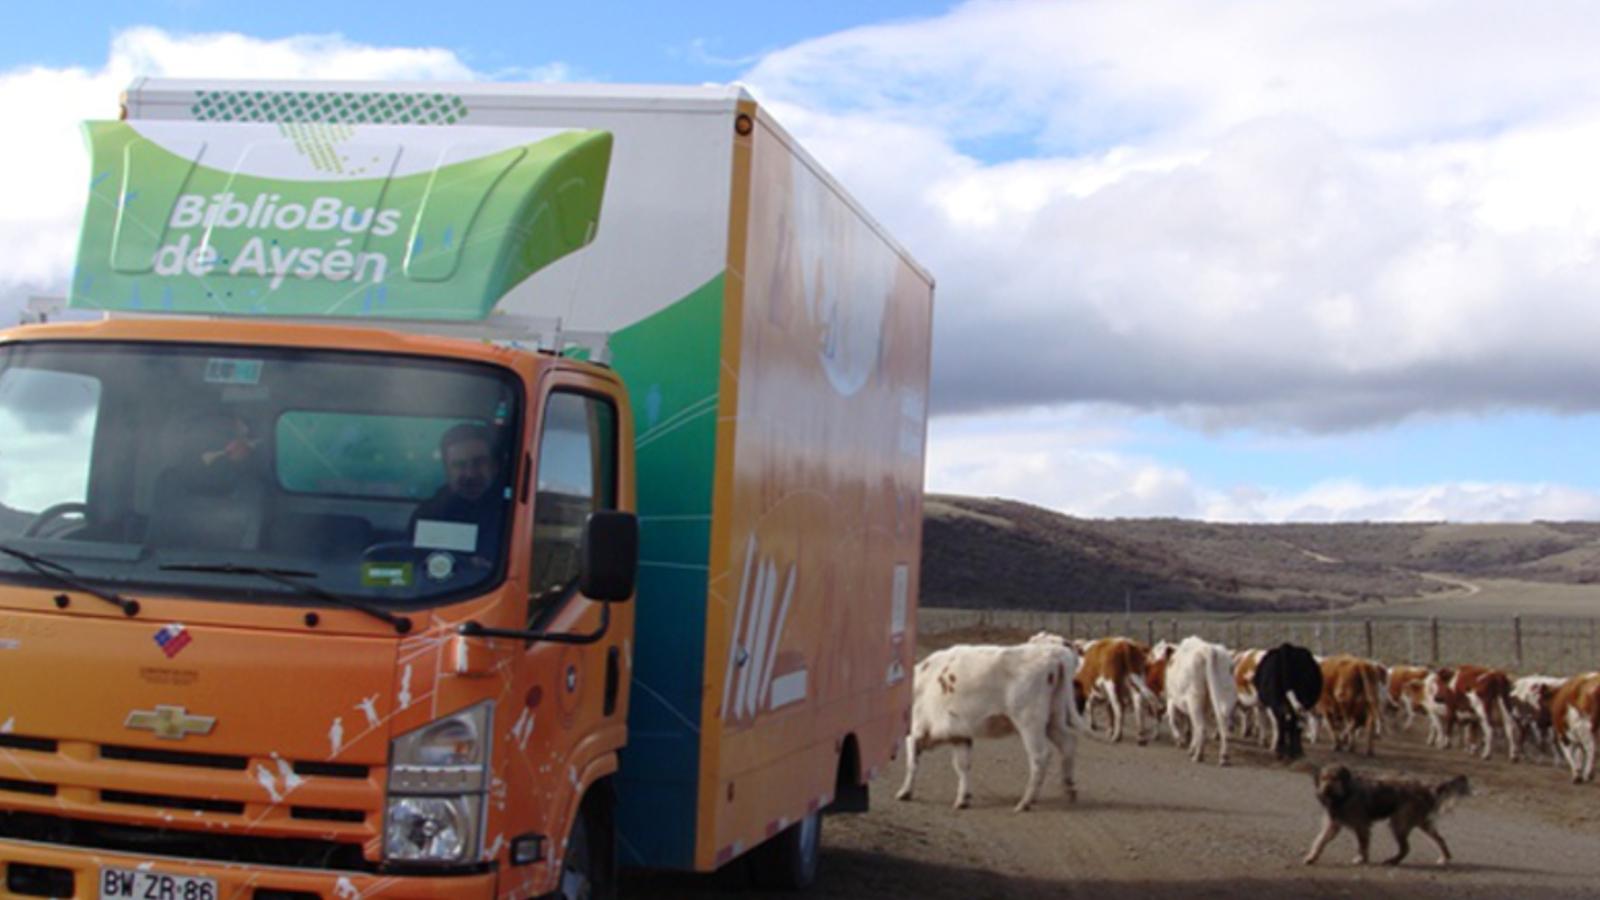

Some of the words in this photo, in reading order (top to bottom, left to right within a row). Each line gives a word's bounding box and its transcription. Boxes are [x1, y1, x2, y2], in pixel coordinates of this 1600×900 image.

[169, 193, 402, 237] BiblioBus
[153, 234, 217, 276] de
[229, 236, 388, 290] Aysén
[104, 869, 135, 896] BW
